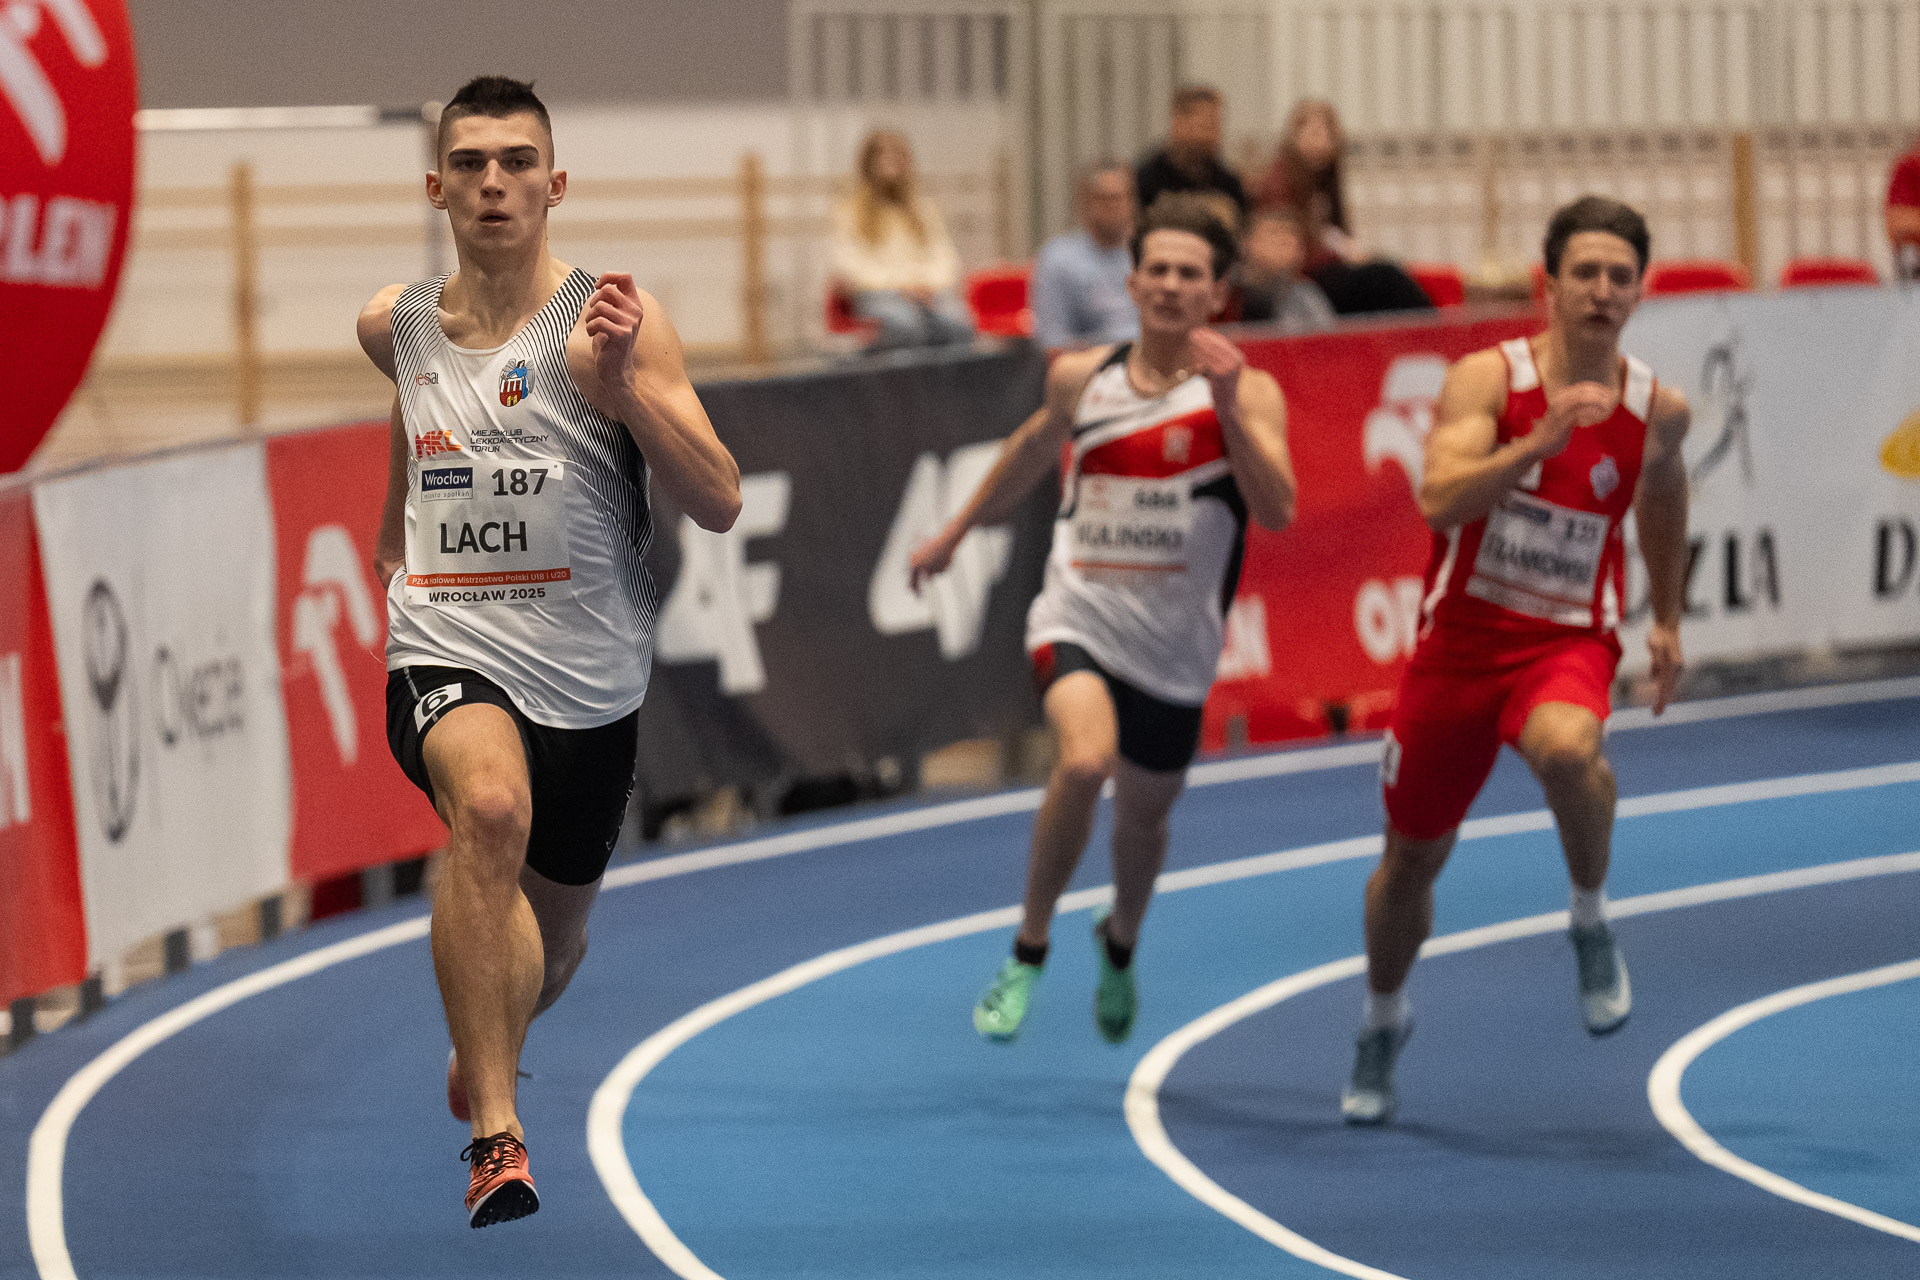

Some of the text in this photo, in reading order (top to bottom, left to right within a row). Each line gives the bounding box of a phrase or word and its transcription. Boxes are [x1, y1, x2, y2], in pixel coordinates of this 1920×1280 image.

[0, 193, 119, 290] LEN
[415, 429, 462, 458] MKL
[470, 444, 501, 453] TORUŃ
[424, 472, 470, 487] Wrocław
[491, 468, 549, 496] 187
[440, 521, 528, 553] LACH
[411, 577, 429, 586] PZLA
[457, 574, 504, 584] Mistrzostwa
[505, 572, 529, 582] Polski
[530, 572, 545, 581] U18
[550, 570, 567, 579] U20
[429, 587, 546, 603] WROCŁAW 2025
[421, 688, 449, 718] 6
